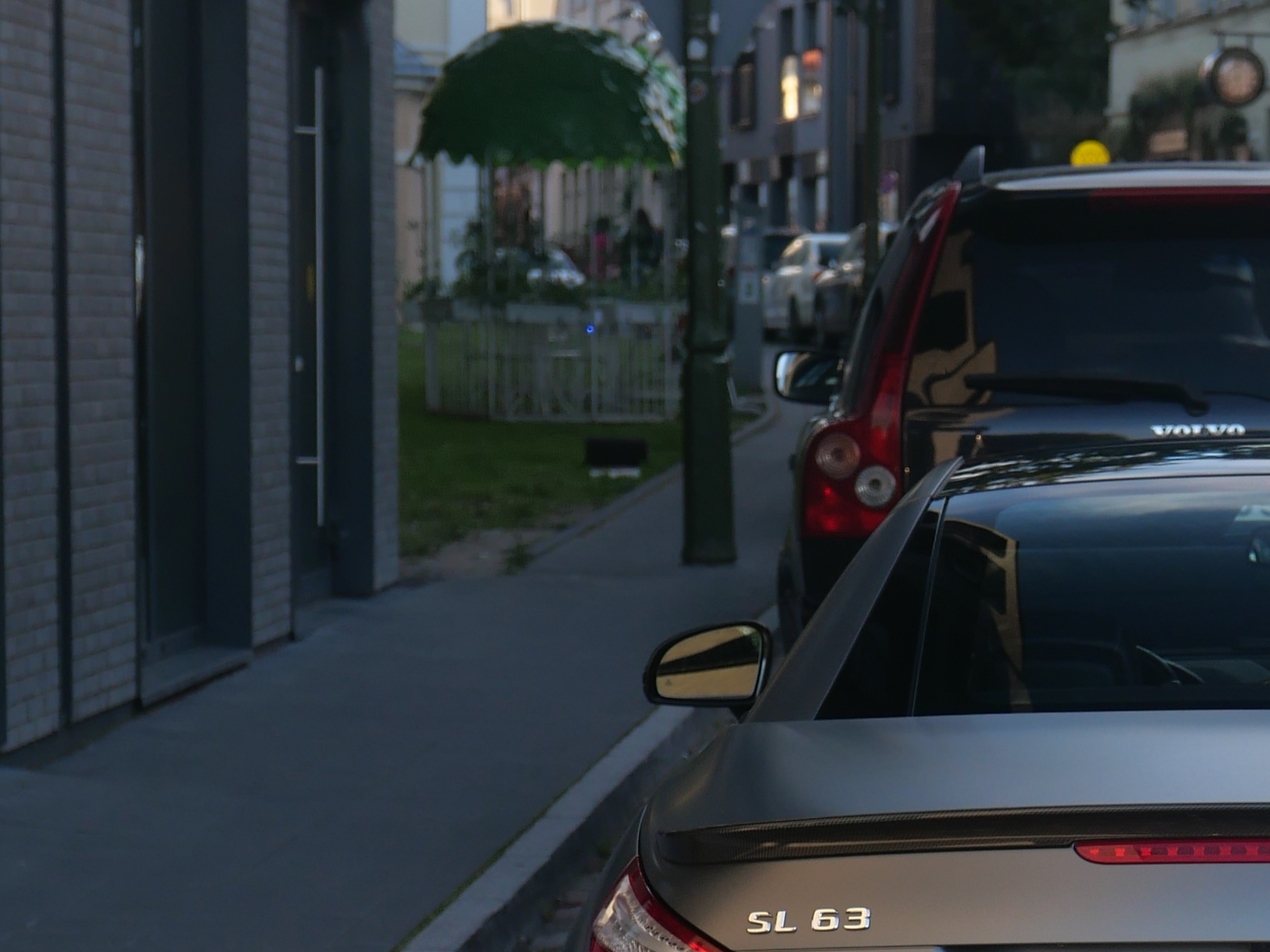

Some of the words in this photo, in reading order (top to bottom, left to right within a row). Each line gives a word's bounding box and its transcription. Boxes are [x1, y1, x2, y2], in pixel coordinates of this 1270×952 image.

[1150, 424, 1246, 437] VOLVO
[746, 910, 797, 933] SL
[811, 907, 871, 931] 63
